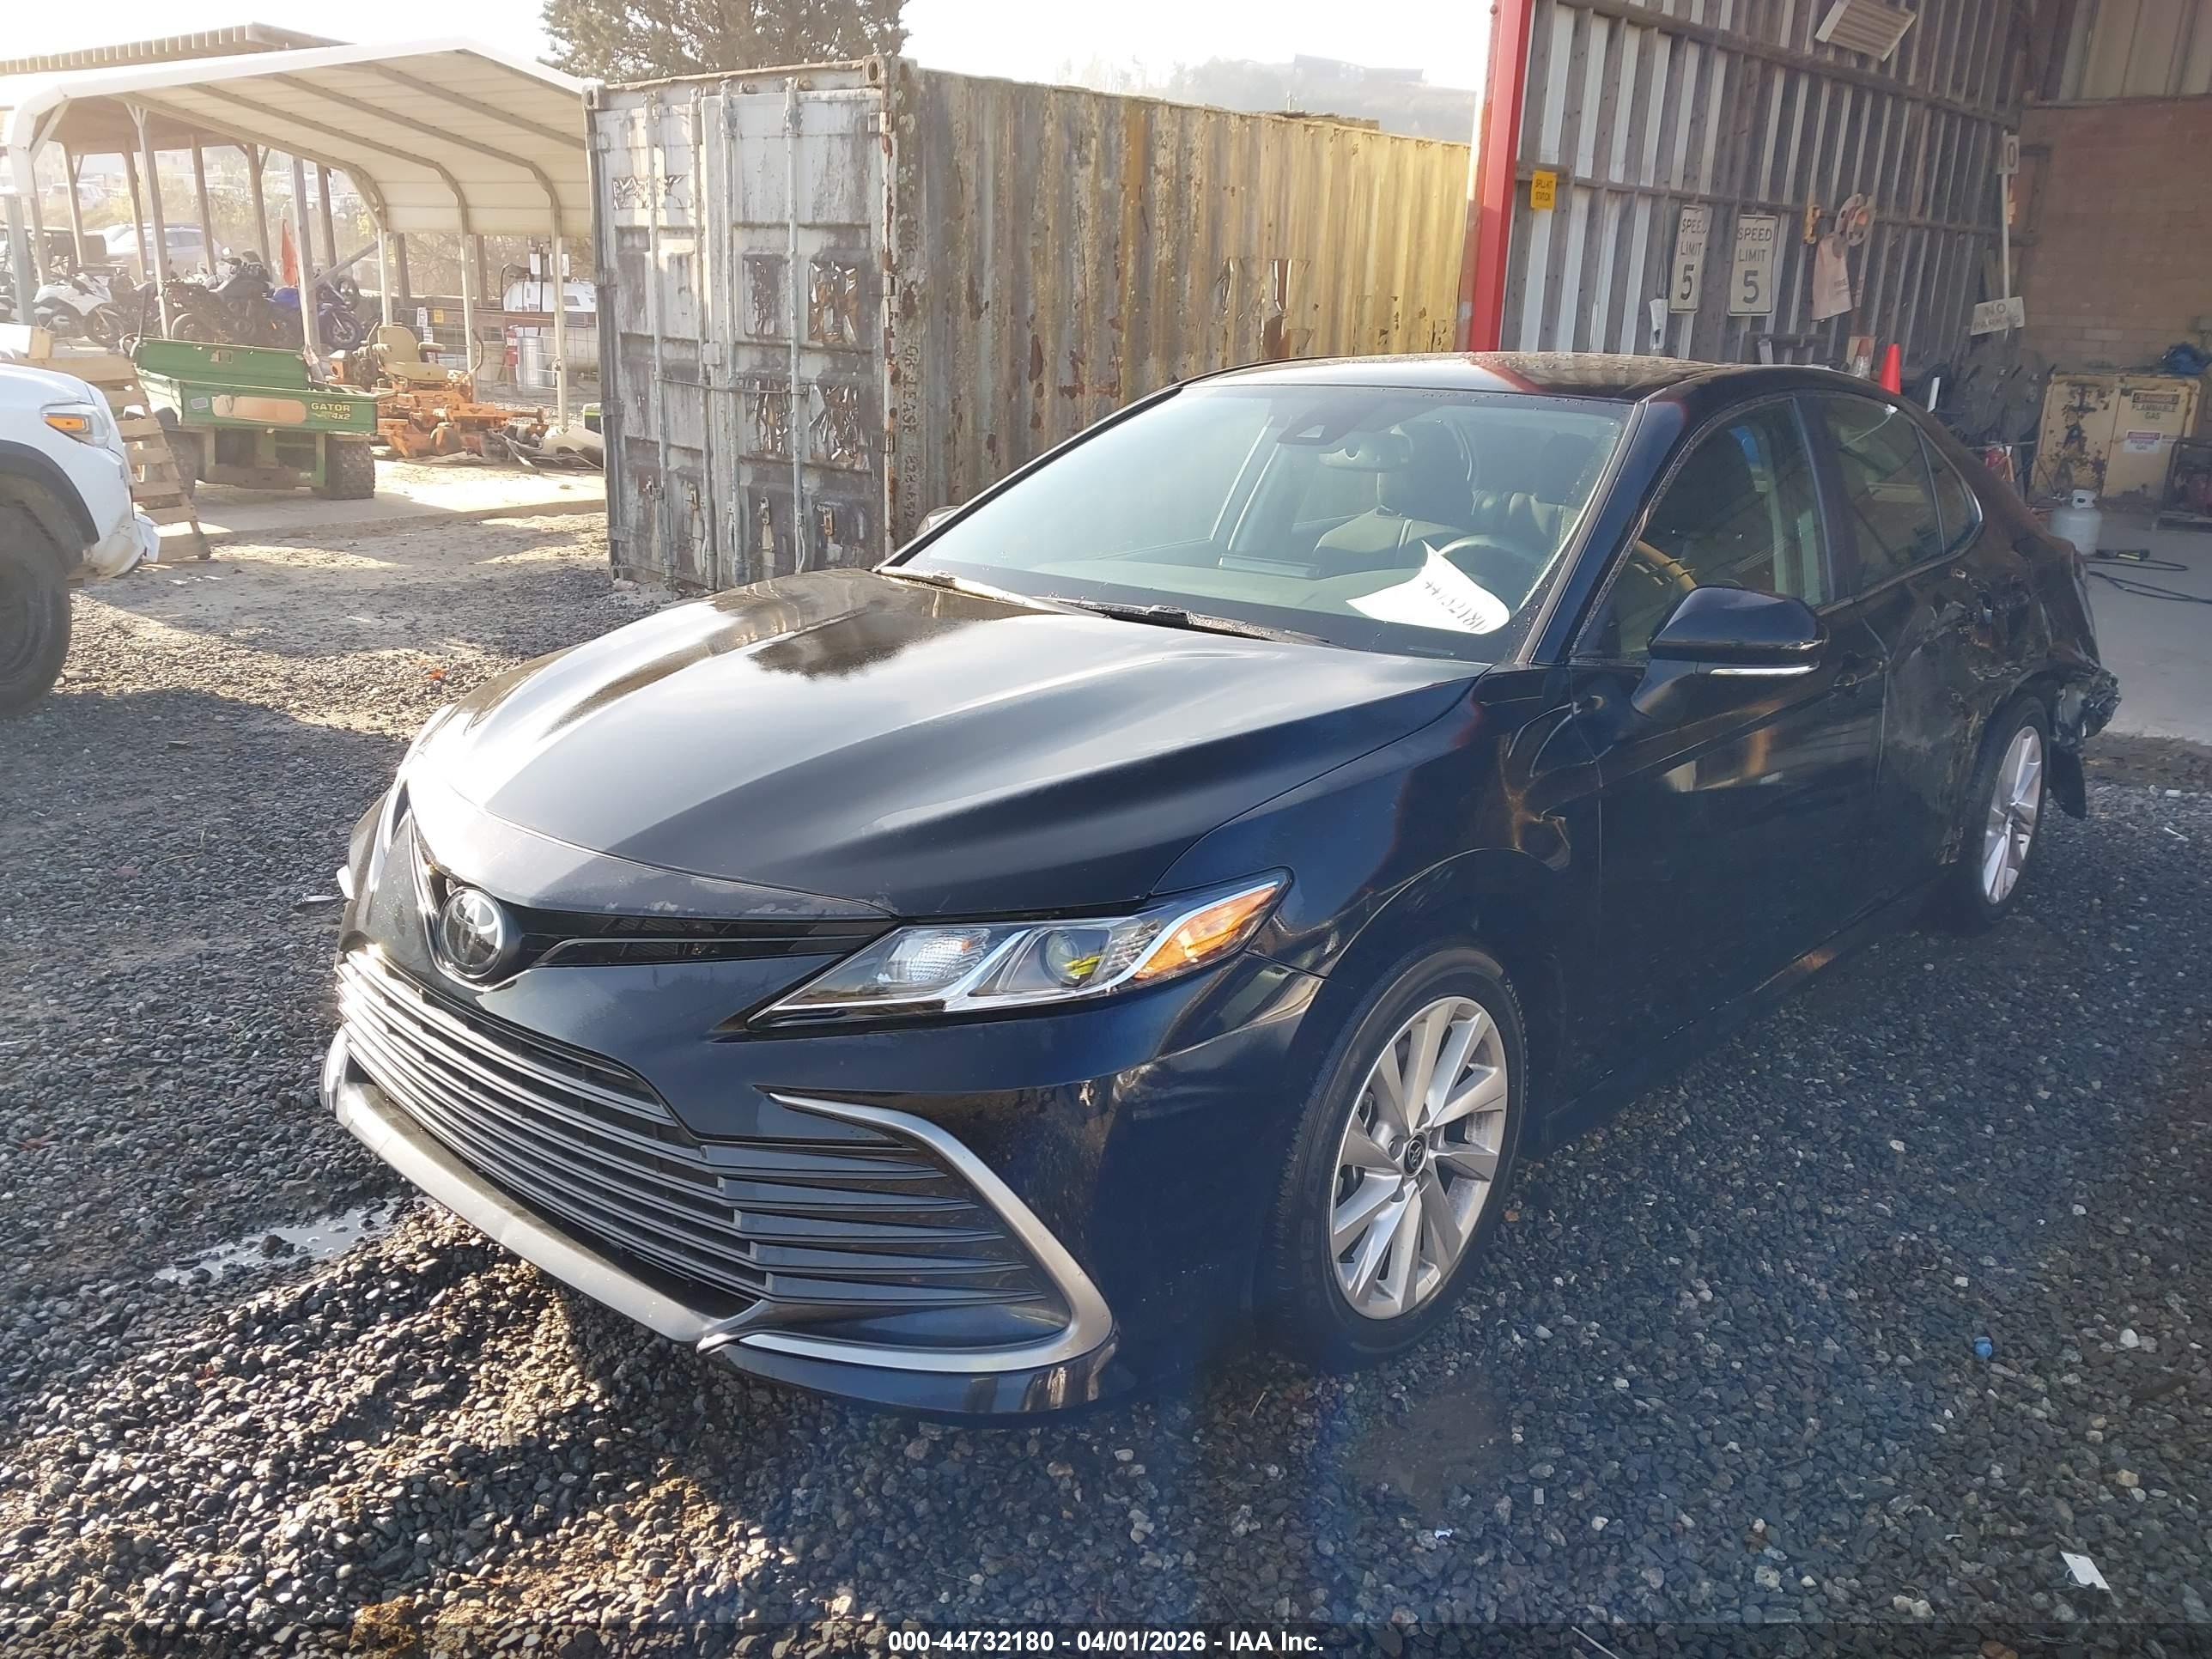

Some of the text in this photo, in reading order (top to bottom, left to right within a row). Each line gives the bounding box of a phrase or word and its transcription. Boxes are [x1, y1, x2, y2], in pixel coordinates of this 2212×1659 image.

[1737, 227, 1772, 241] SPEED
[1680, 241, 1703, 255] LIMIT
[1738, 249, 1766, 262] LIMIT
[1680, 264, 1695, 301] 5
[1743, 270, 1759, 303] 5
[1985, 302, 2006, 315] NO
[311, 402, 350, 412] GATOR
